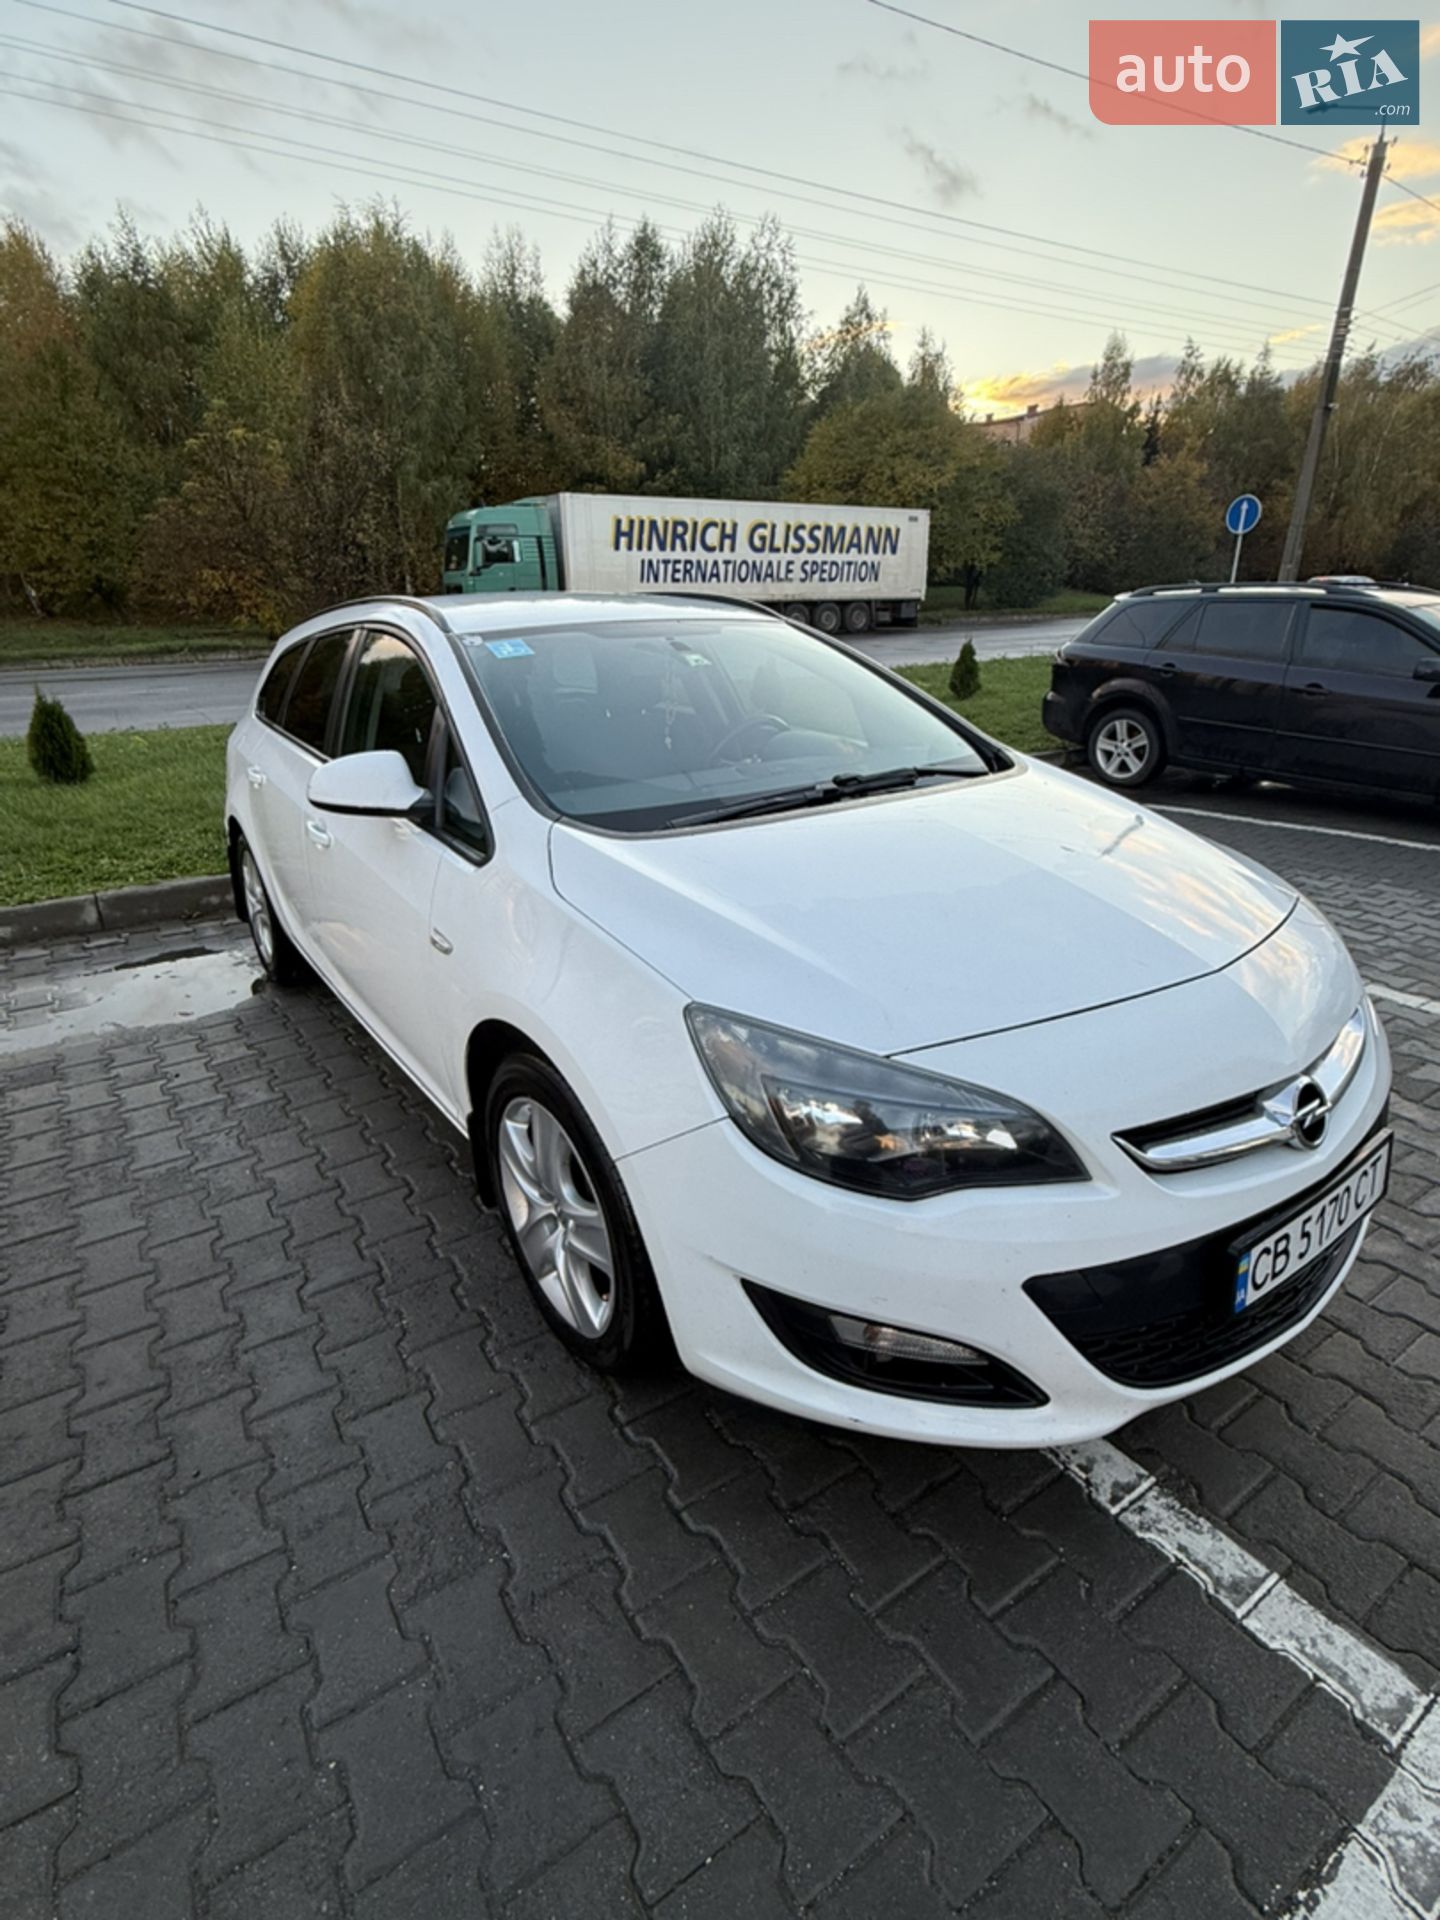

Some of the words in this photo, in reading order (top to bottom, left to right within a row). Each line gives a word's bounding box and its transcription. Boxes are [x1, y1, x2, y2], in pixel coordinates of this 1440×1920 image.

[612, 515, 738, 552] HINRICH
[746, 519, 901, 555] GLISSMANN
[640, 558, 794, 584] INTERNATIONALE
[799, 560, 881, 583] SPEDITION
[1251, 1232, 1291, 1291] CB
[1297, 1185, 1351, 1260] 5170
[1354, 1155, 1382, 1210] CT
